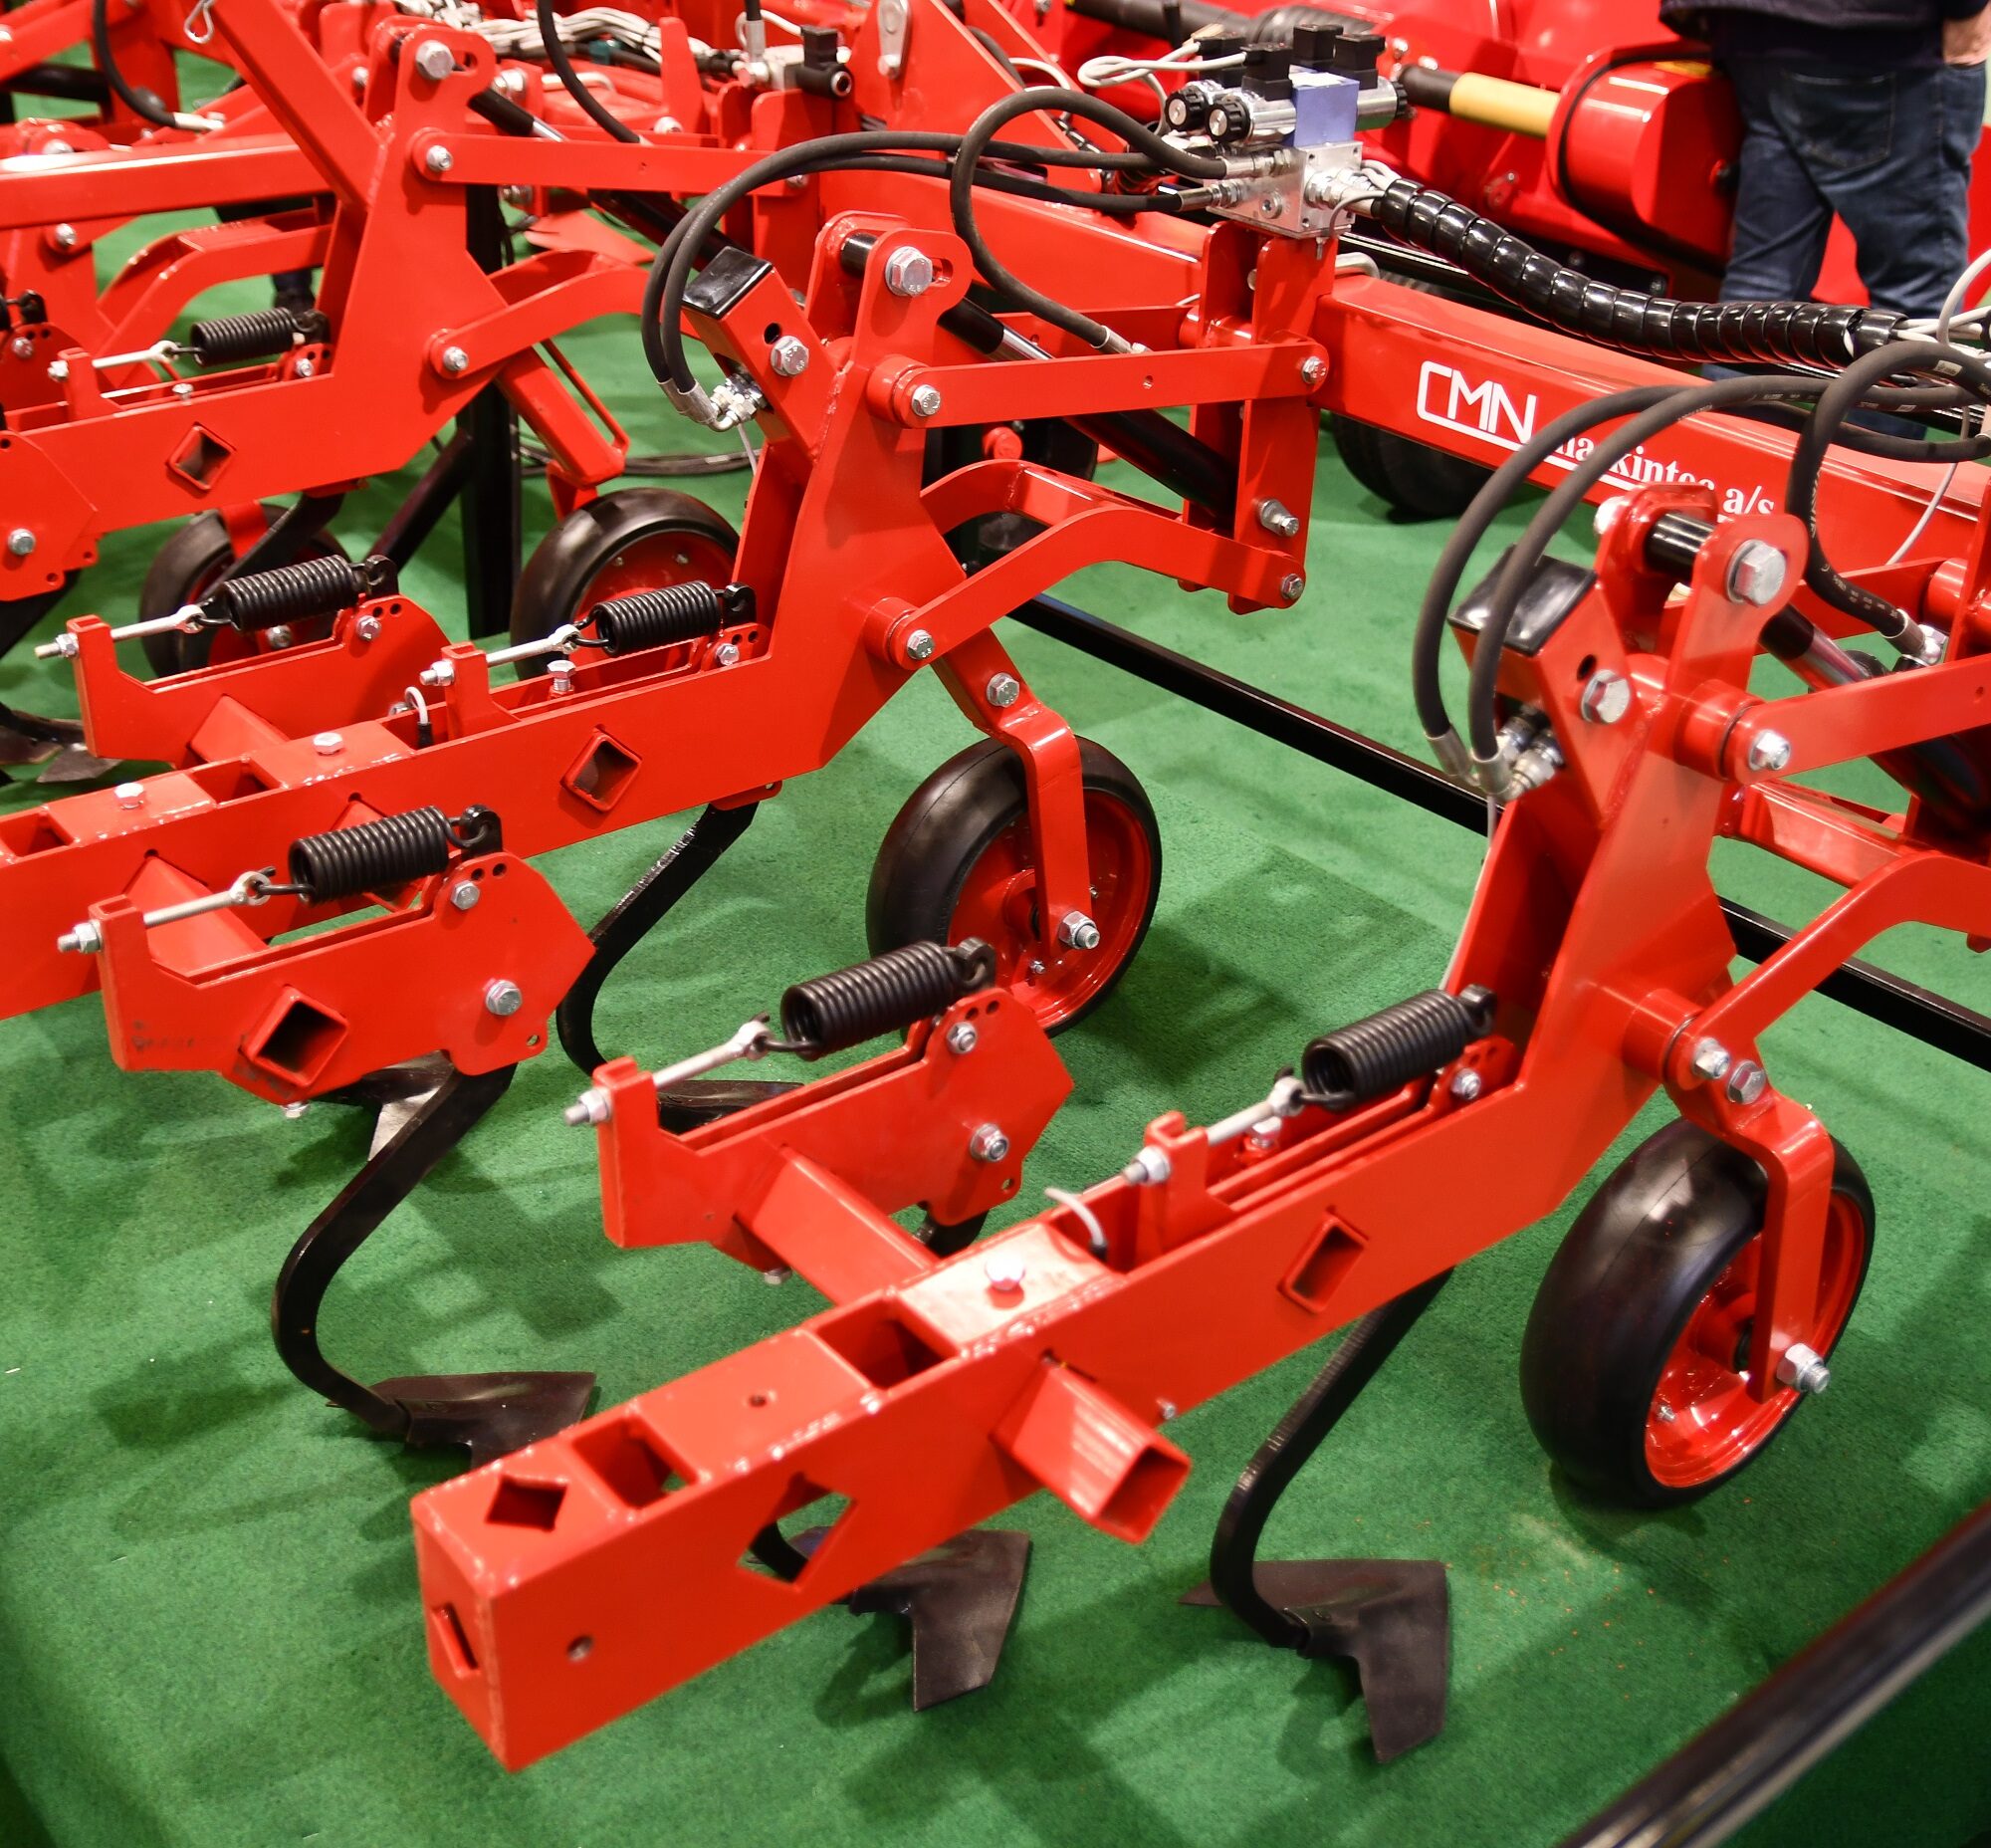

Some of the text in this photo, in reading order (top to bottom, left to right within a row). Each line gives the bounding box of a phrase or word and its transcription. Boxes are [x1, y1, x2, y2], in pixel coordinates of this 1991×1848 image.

[1417, 360, 1537, 447] CMN
[1554, 436, 1716, 491] akint
[1723, 485, 1775, 515] a/s
